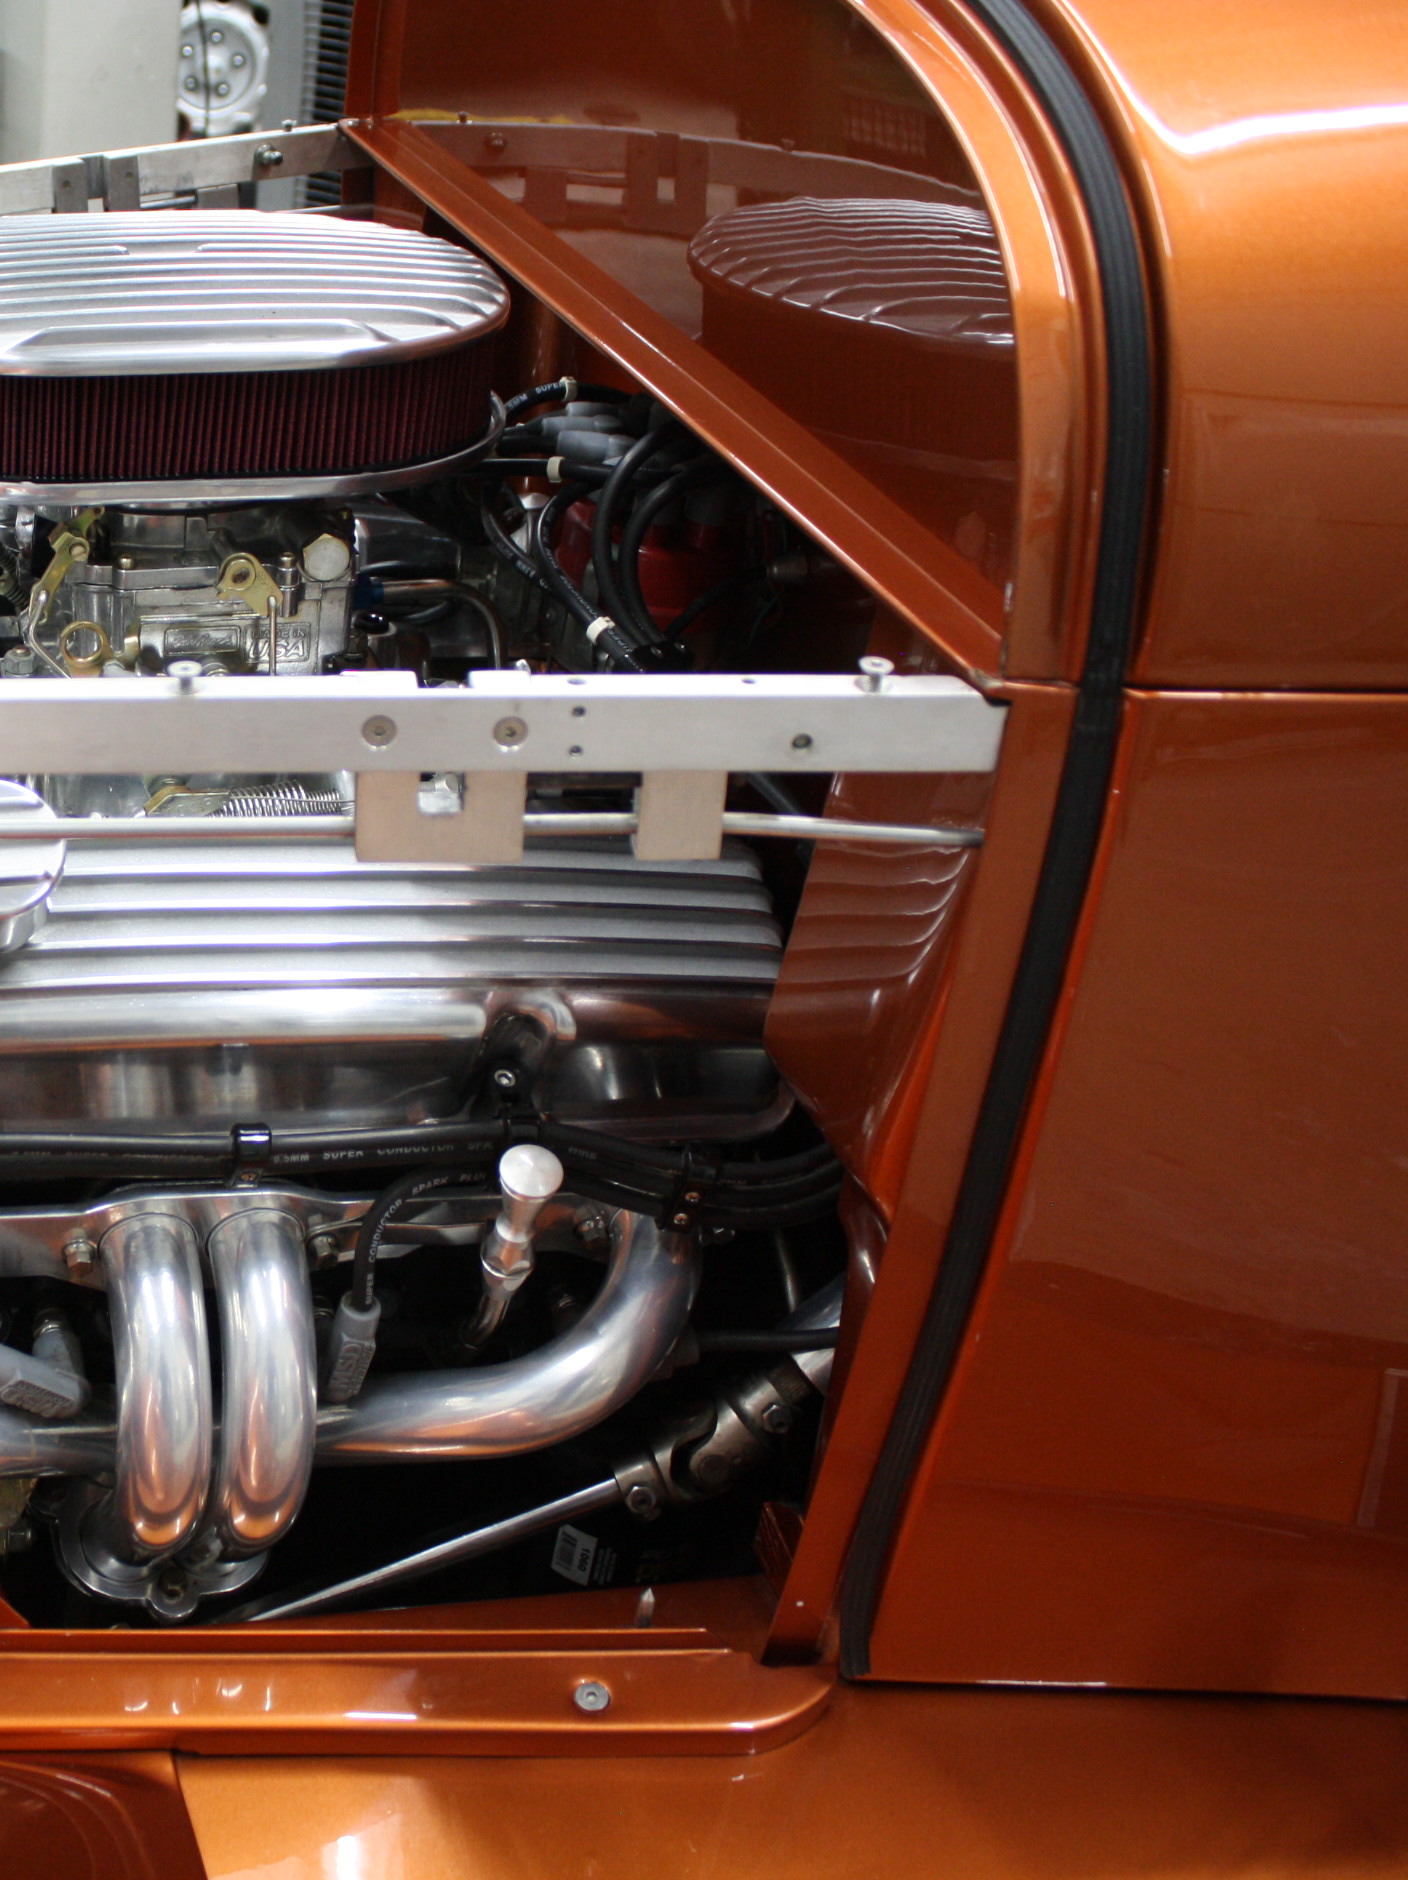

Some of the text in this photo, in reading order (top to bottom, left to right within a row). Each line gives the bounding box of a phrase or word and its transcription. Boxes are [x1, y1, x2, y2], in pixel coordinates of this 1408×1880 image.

[248, 639, 305, 658] USA
[293, 628, 306, 637] IN
[368, 1198, 403, 1263] CONDUCTOR
[411, 1176, 449, 1196] SPARK
[330, 1344, 362, 1391] MSD
